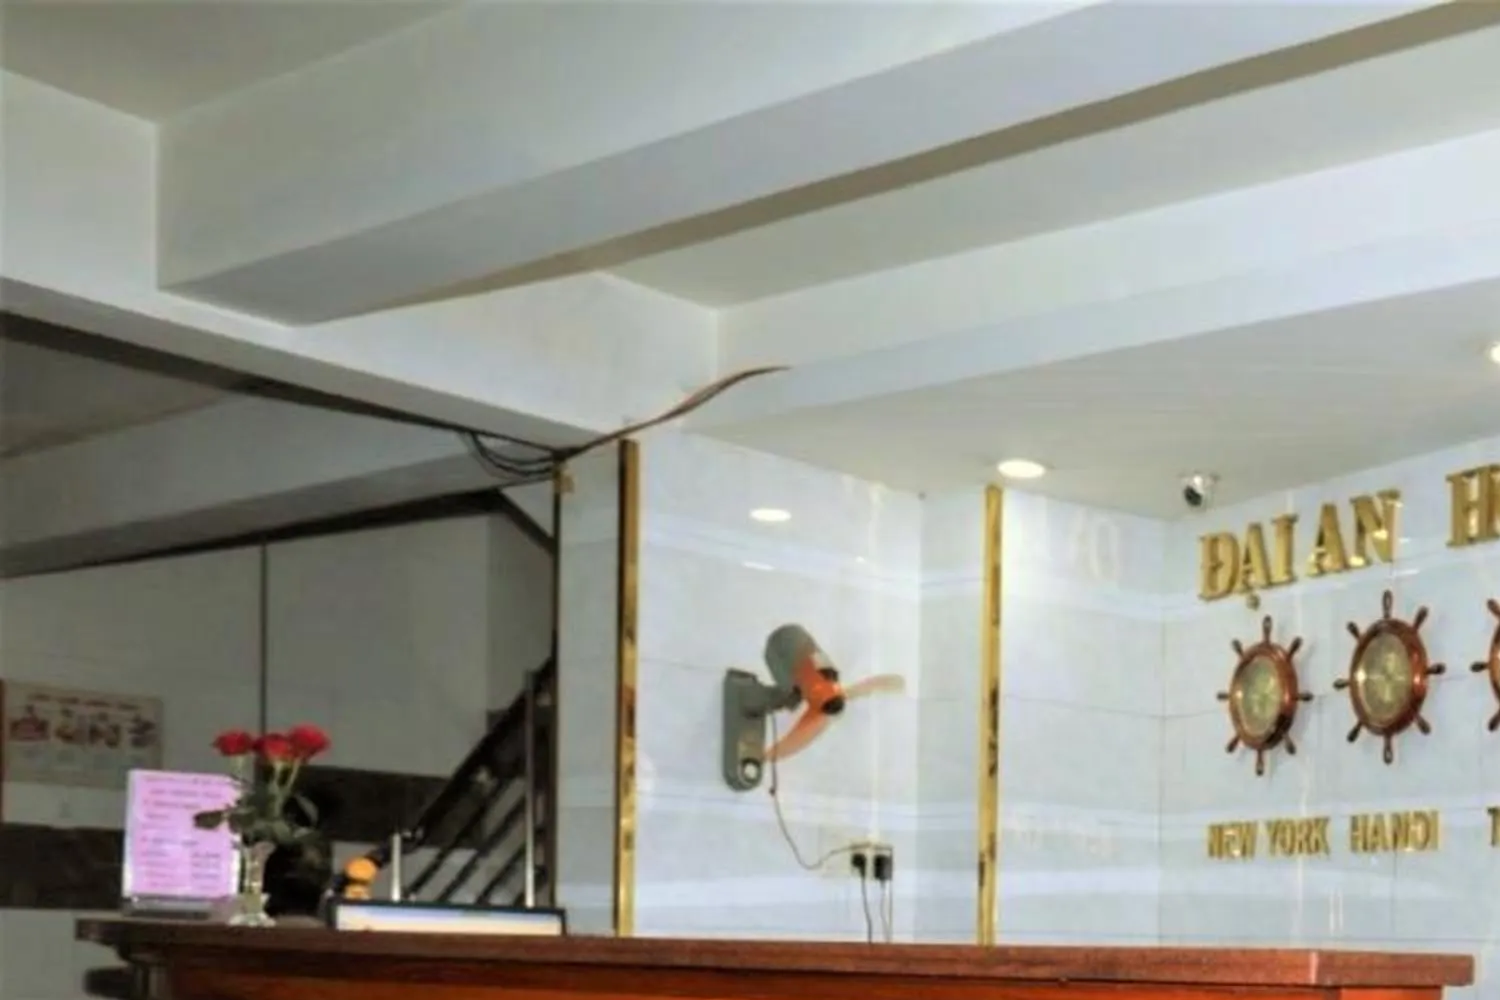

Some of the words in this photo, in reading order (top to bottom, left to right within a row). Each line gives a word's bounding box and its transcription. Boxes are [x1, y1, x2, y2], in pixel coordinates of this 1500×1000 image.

[1307, 488, 1401, 577] AN
[1207, 820, 1257, 859] NEW
[1267, 817, 1329, 857] YORK
